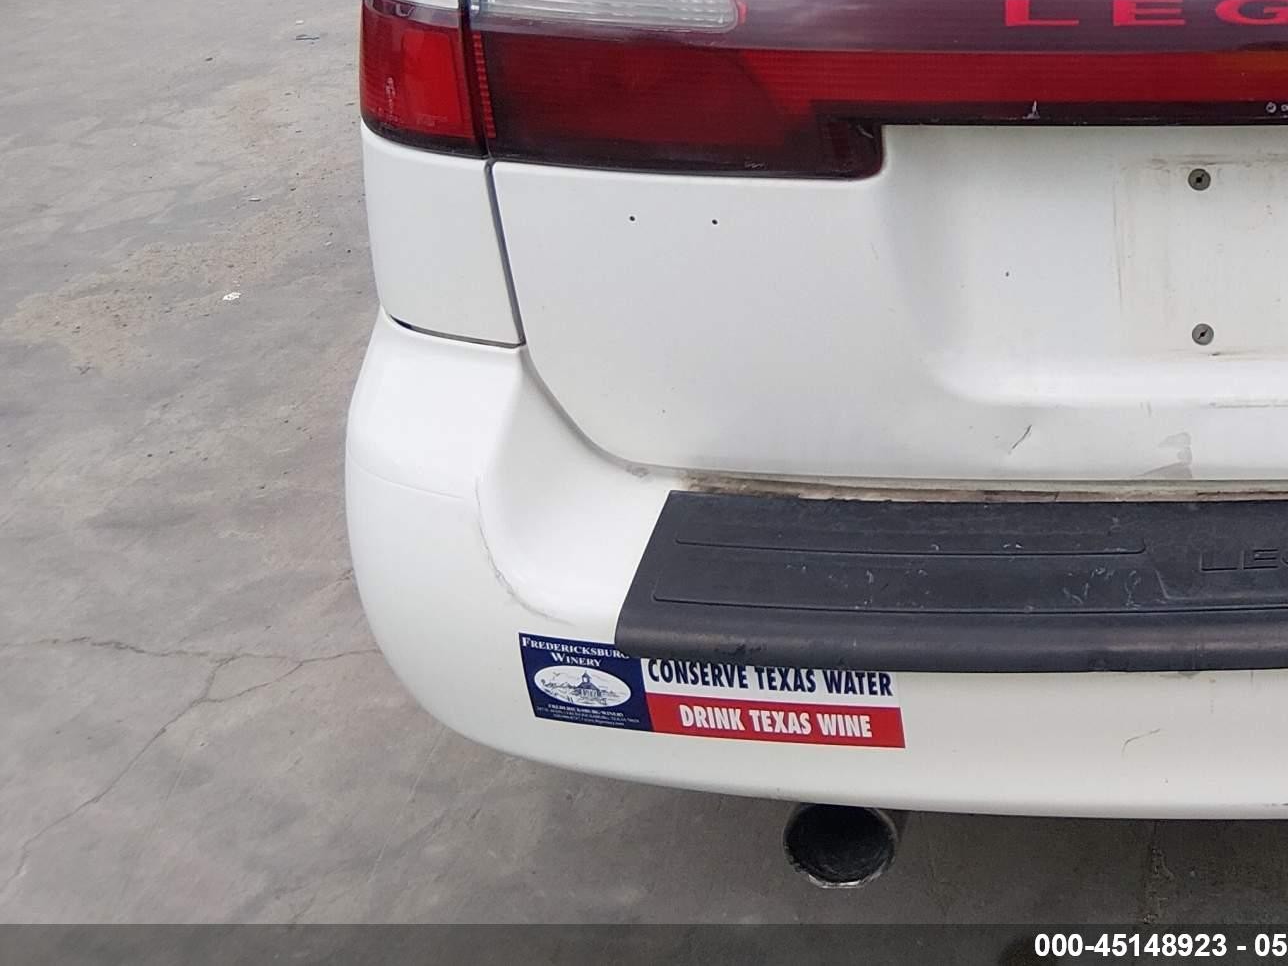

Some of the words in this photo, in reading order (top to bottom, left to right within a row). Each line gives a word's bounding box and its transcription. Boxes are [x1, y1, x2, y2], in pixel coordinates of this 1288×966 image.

[551, 652, 602, 668] WINERY
[648, 658, 749, 690] CONSERVE
[757, 665, 817, 694] TEXAS
[823, 670, 894, 697] WATER
[678, 704, 746, 732] DRINK
[750, 708, 813, 736] TEXAS
[816, 712, 873, 739] WINE
